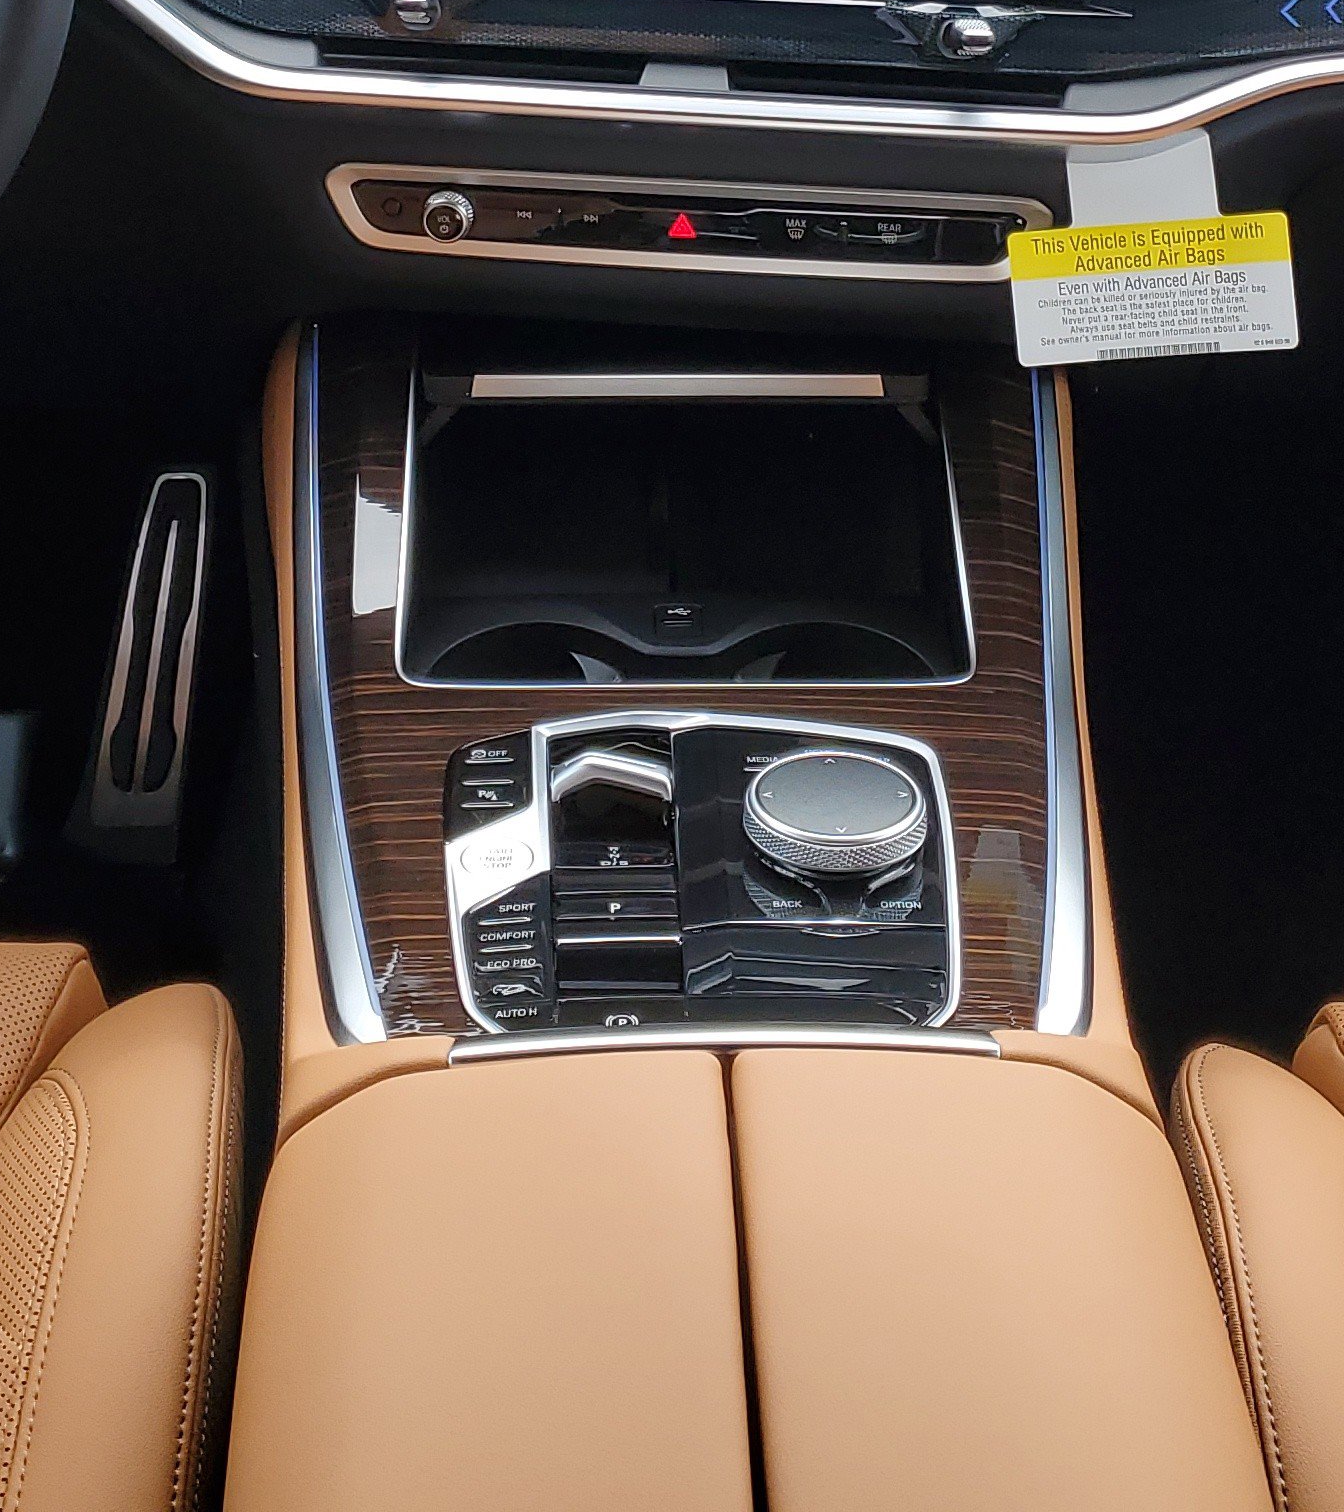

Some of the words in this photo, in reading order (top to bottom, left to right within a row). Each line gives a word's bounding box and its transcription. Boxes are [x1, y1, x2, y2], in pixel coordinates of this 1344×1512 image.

[437, 215, 451, 223] VOL
[785, 218, 807, 228] MAX
[877, 222, 902, 233] REAR
[1031, 238, 1065, 255] This
[1070, 233, 1127, 252] Vehicle
[1132, 231, 1146, 247] is
[1151, 223, 1225, 247] Equipped
[1230, 222, 1264, 239] with
[1075, 250, 1152, 272] Advanced
[1157, 248, 1180, 266] Air
[1186, 247, 1225, 265] Bags
[1058, 282, 1090, 296] Even
[1092, 278, 1120, 293] with
[1124, 273, 1188, 291] Advanced
[1192, 271, 1210, 286] Air
[1215, 270, 1246, 285] Bags
[1038, 298, 1071, 308] Children
[1091, 295, 1101, 304] be
[1103, 293, 1125, 303] killed
[1128, 294, 1136, 302] or
[1139, 290, 1176, 300] seriously
[1179, 287, 1208, 298] injured
[1210, 287, 1220, 297] by
[1223, 285, 1235, 294] the
[1238, 285, 1248, 293] air
[1062, 307, 1076, 316] The
[1079, 306, 1098, 314] back
[1101, 304, 1117, 313] seat
[1120, 303, 1127, 311] is
[1129, 301, 1142, 310] the
[1146, 299, 1170, 309] safest
[1172, 298, 1194, 308] place
[1197, 296, 1208, 306] for
[1062, 316, 1085, 326] Never
[1088, 315, 1101, 324] put
[1111, 310, 1155, 322] rear-facing
[1158, 307, 1178, 318] child
[1180, 307, 1197, 316] seat
[1200, 306, 1208, 315] in
[1211, 305, 1223, 314] the
[1070, 325, 1099, 335] Always
[1101, 324, 1115, 332] use
[1118, 322, 1135, 331] seat
[1137, 320, 1157, 329] belts
[1160, 318, 1175, 327] and
[1178, 316, 1198, 326] child
[1040, 337, 1056, 347] See
[1058, 334, 1090, 345] owner's
[1092, 332, 1122, 342] manual
[1124, 330, 1136, 339] for
[1138, 329, 1160, 338] more
[1162, 325, 1210, 337] information
[1213, 323, 1236, 333] about
[1238, 323, 1249, 332] air
[487, 749, 508, 757] OFF
[746, 756, 778, 764] MEDIA
[498, 902, 536, 913] SPORT
[610, 902, 621, 914] P
[772, 900, 803, 909] BACK
[880, 900, 922, 910] OPTION
[479, 930, 536, 942] COMFORT
[513, 958, 537, 967] PRO
[494, 1008, 527, 1019] AUTO
[528, 1007, 538, 1017] H
